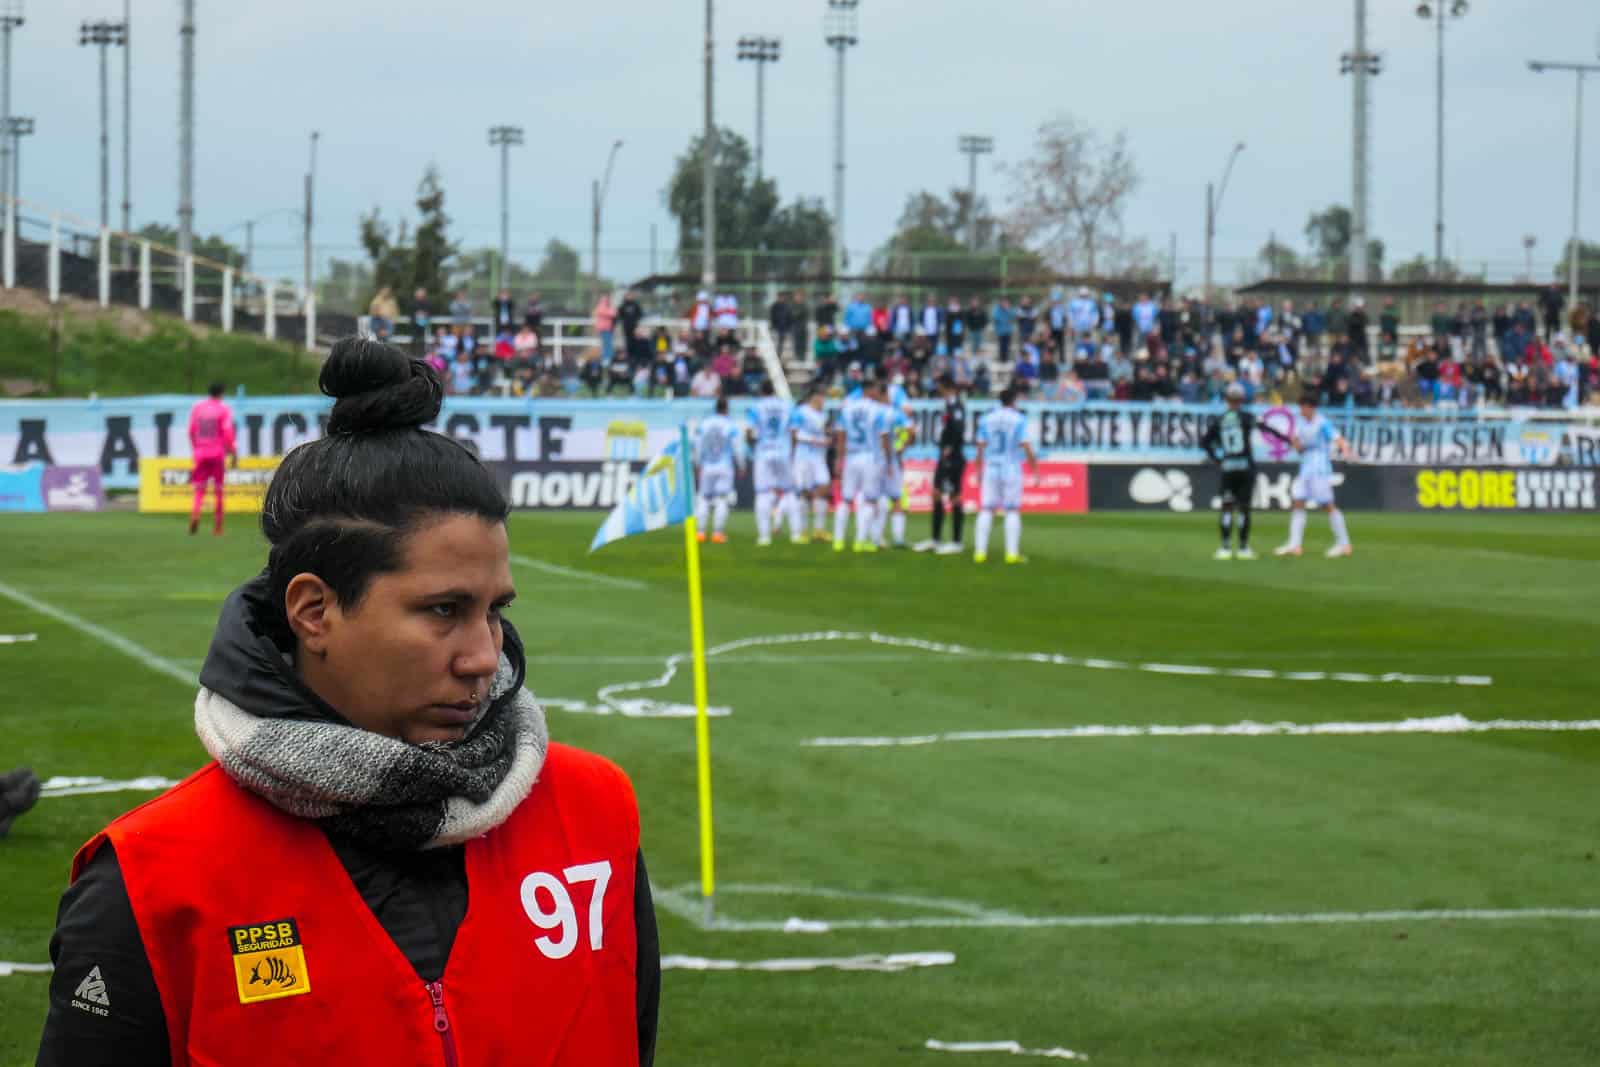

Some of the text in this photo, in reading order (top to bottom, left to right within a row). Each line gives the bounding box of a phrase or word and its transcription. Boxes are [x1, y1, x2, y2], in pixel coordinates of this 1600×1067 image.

[1041, 410, 1120, 448] EXISTE
[1128, 411, 1142, 448] Y
[511, 462, 640, 508] novib
[1416, 470, 1517, 509] SCORE
[520, 860, 612, 959] 97
[234, 922, 292, 945] PPSB
[237, 937, 294, 953] SEGURIDAD
[71, 999, 90, 1011] SINCE
